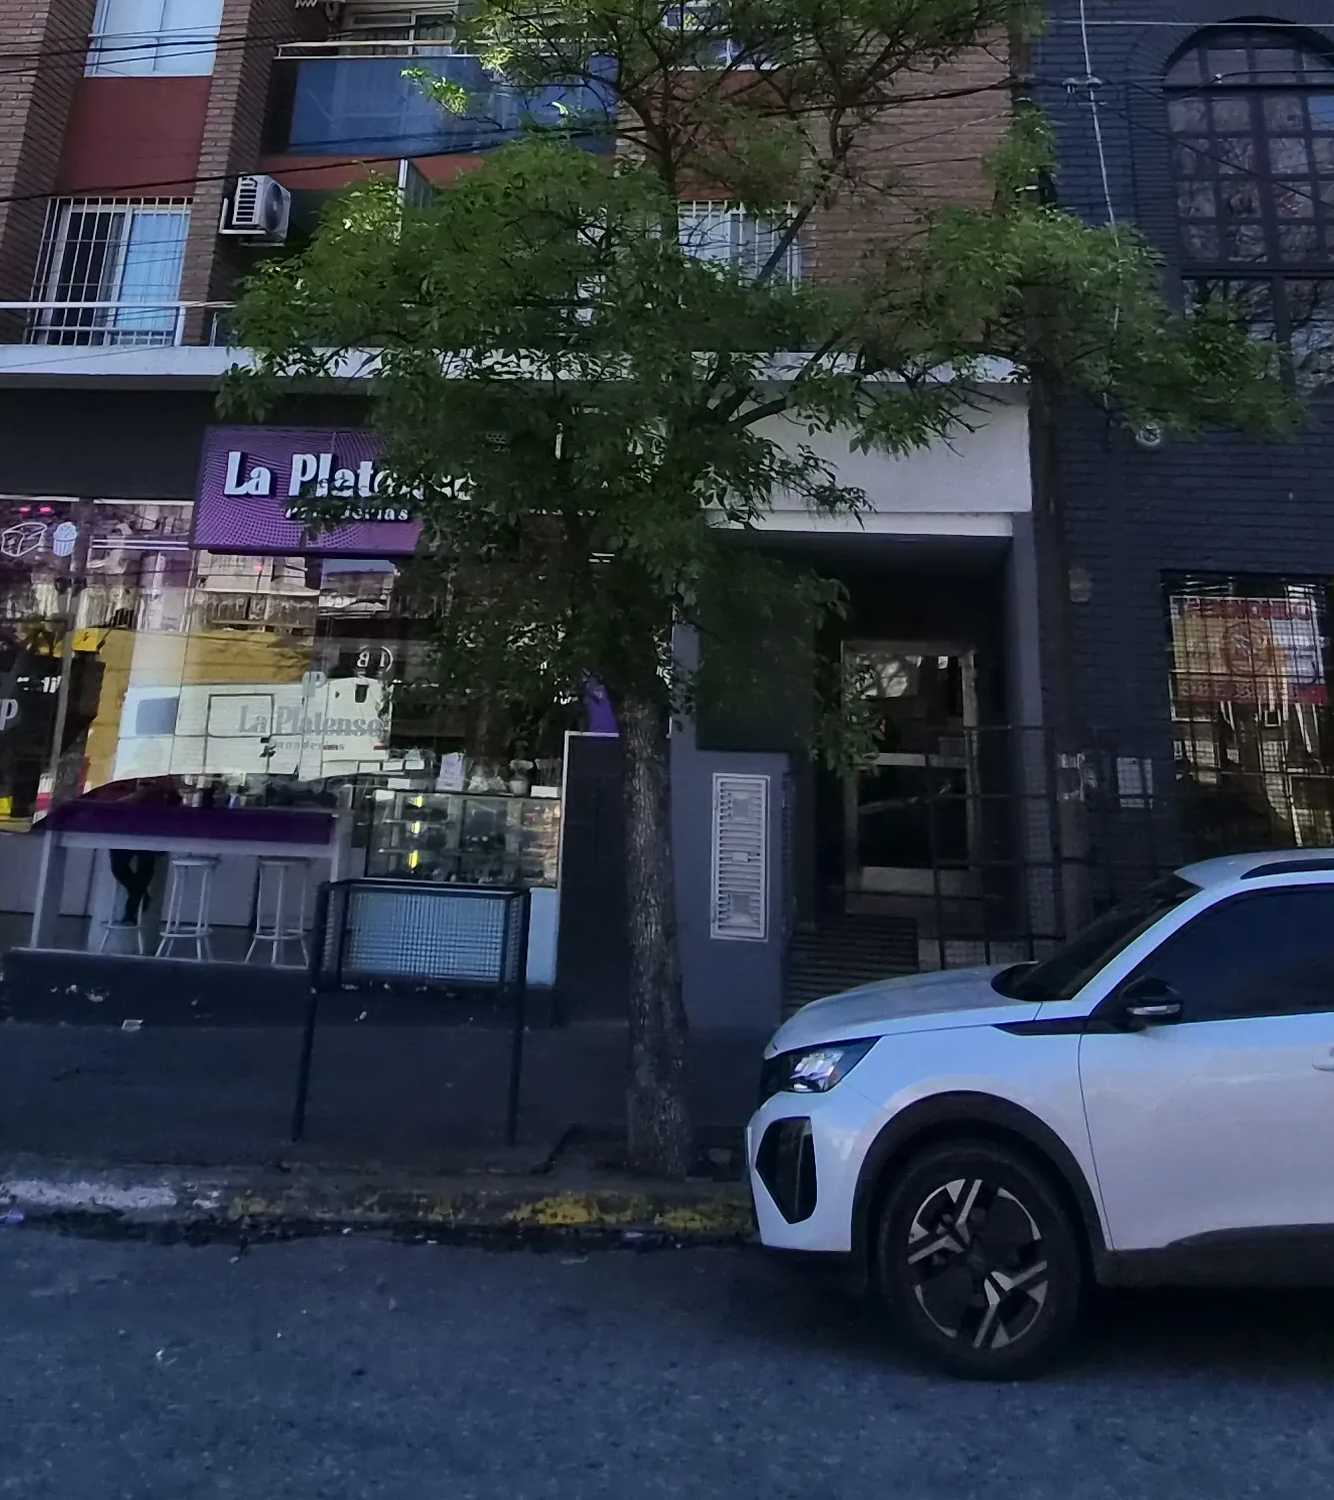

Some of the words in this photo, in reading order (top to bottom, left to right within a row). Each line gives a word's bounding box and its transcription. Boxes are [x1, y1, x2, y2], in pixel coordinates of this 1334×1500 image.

[223, 451, 272, 496] La
[288, 452, 478, 501] Platee
[237, 704, 268, 734] La
[275, 704, 385, 738] Platense
